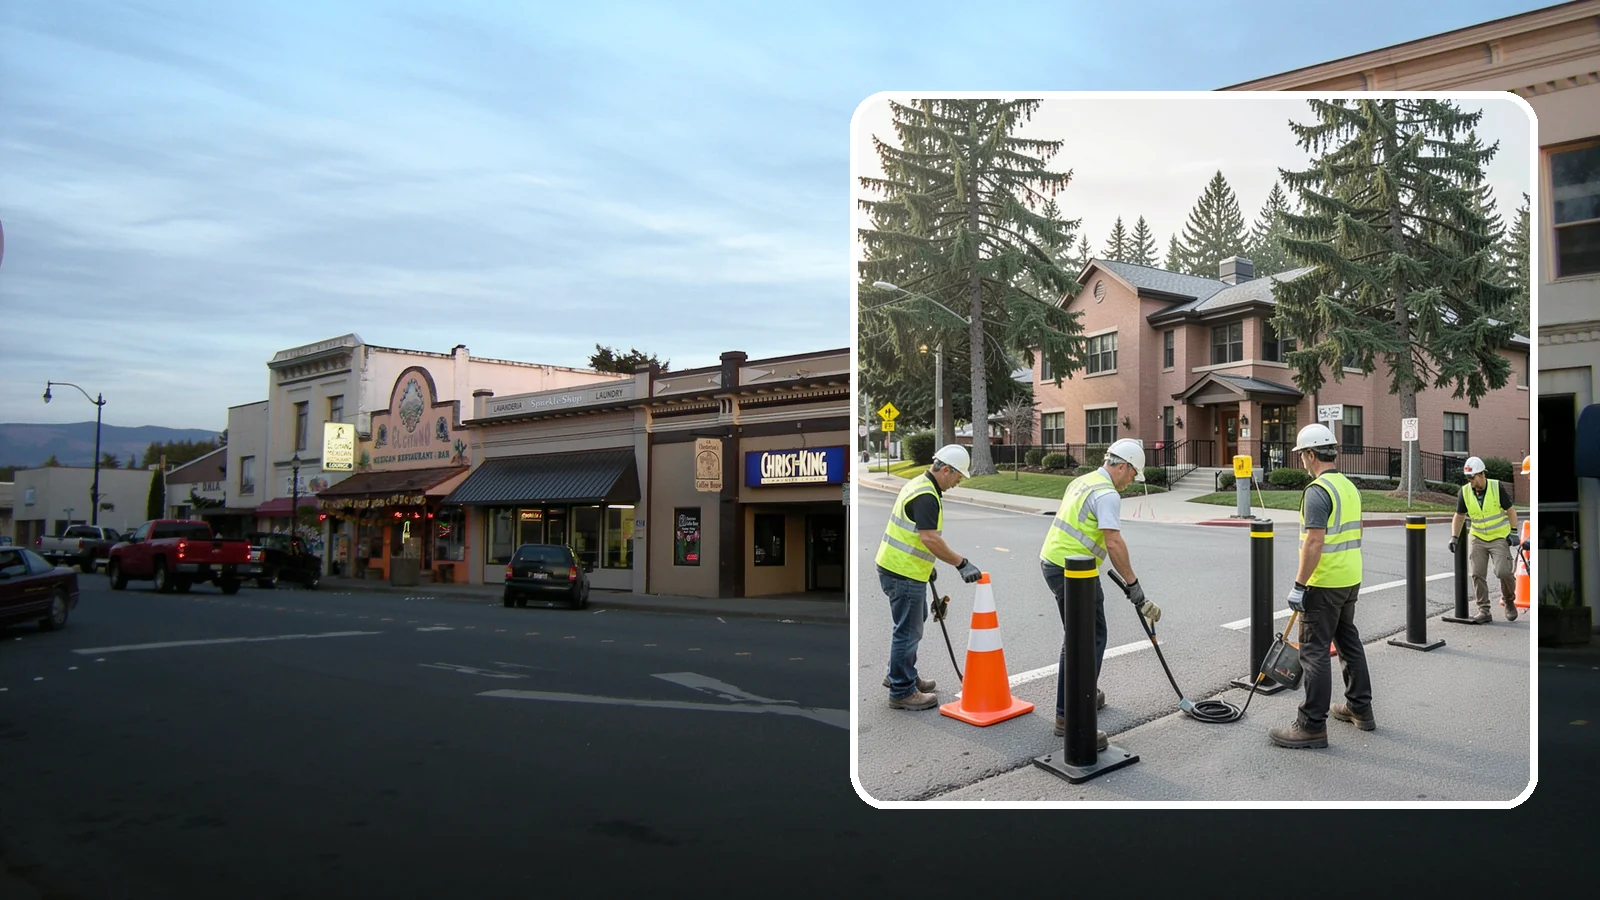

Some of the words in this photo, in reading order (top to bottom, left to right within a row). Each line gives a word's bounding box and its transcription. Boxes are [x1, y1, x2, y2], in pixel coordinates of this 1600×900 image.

[530, 396, 561, 408] Sparkle
[562, 394, 583, 405] Shop
[595, 389, 624, 400] LAUNDRY
[493, 402, 523, 413] LAVANDERIA
[373, 454, 396, 464] MEXICAN
[397, 451, 433, 462] RESTAURANT
[438, 450, 450, 459] BAR
[760, 452, 797, 478] CHRIST
[799, 450, 827, 476] KING
